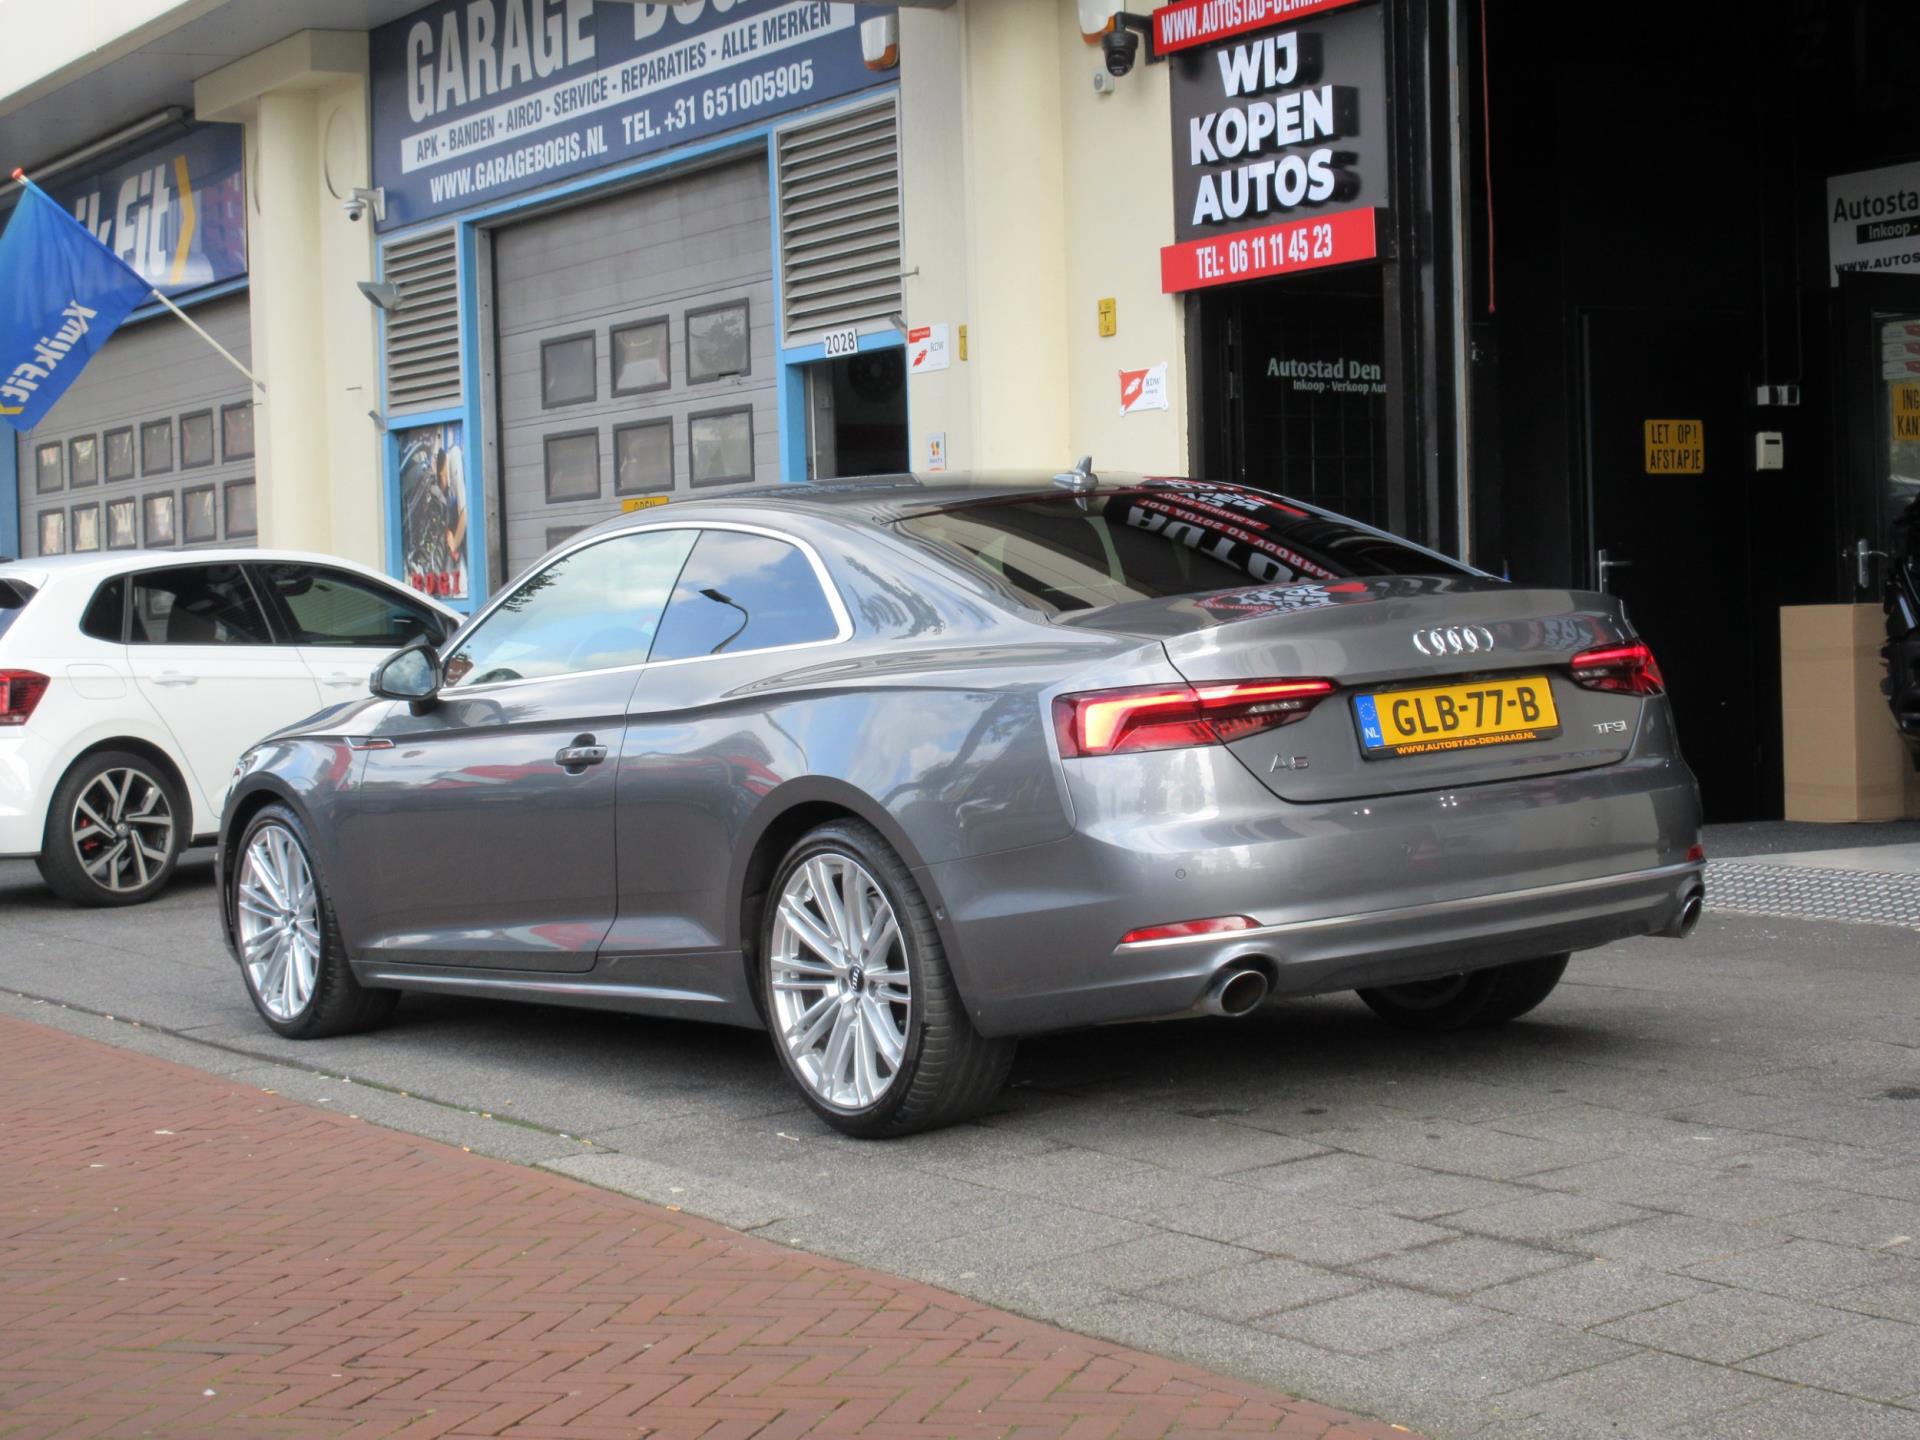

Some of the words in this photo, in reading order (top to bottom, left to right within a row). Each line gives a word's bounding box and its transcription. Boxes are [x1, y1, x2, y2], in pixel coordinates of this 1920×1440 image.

[407, 0, 595, 123] GARAGE
[1217, 30, 1298, 97] WIJ
[416, 134, 438, 163] APK
[448, 115, 495, 151] BANDEN
[506, 99, 542, 133] AIRCO
[553, 75, 608, 116] SERVICE
[621, 42, 707, 94] REPARATIES
[721, 25, 758, 60] ALLE
[762, 2, 832, 46] MERKEN
[430, 125, 608, 203] WWW.GARAGEBOGIS.NL
[621, 109, 661, 145] TEL.
[664, 95, 695, 132] +31
[702, 59, 814, 121] 651005905
[1190, 84, 1334, 166] KOPEN
[1192, 148, 1335, 226] AUTOS
[1833, 189, 1919, 223] Autosta
[1868, 223, 1911, 239] Inkoop
[1195, 245, 1224, 280] TEL:
[1229, 239, 1248, 274] 06
[1252, 236, 1266, 269] 11
[1270, 232, 1284, 266] 11
[1288, 228, 1309, 262] 45
[1313, 223, 1333, 259] 23
[825, 331, 855, 355] 2028
[1267, 357, 1344, 379] Autostad
[1349, 360, 1382, 380] Den
[1293, 379, 1325, 393] Inkoop
[1331, 381, 1369, 395] Verkoop
[1651, 424, 1670, 444] LET
[1677, 424, 1697, 444] OP!
[1897, 415, 1920, 436] KAN
[1650, 449, 1701, 470] AFSTAPJE
[1391, 686, 1541, 737] GLB-77-B
[1365, 727, 1380, 739] NL
[1593, 720, 1627, 734] TFSI
[1396, 731, 1537, 755] WWW.AUTOSTAD-DENHAAG.NL
